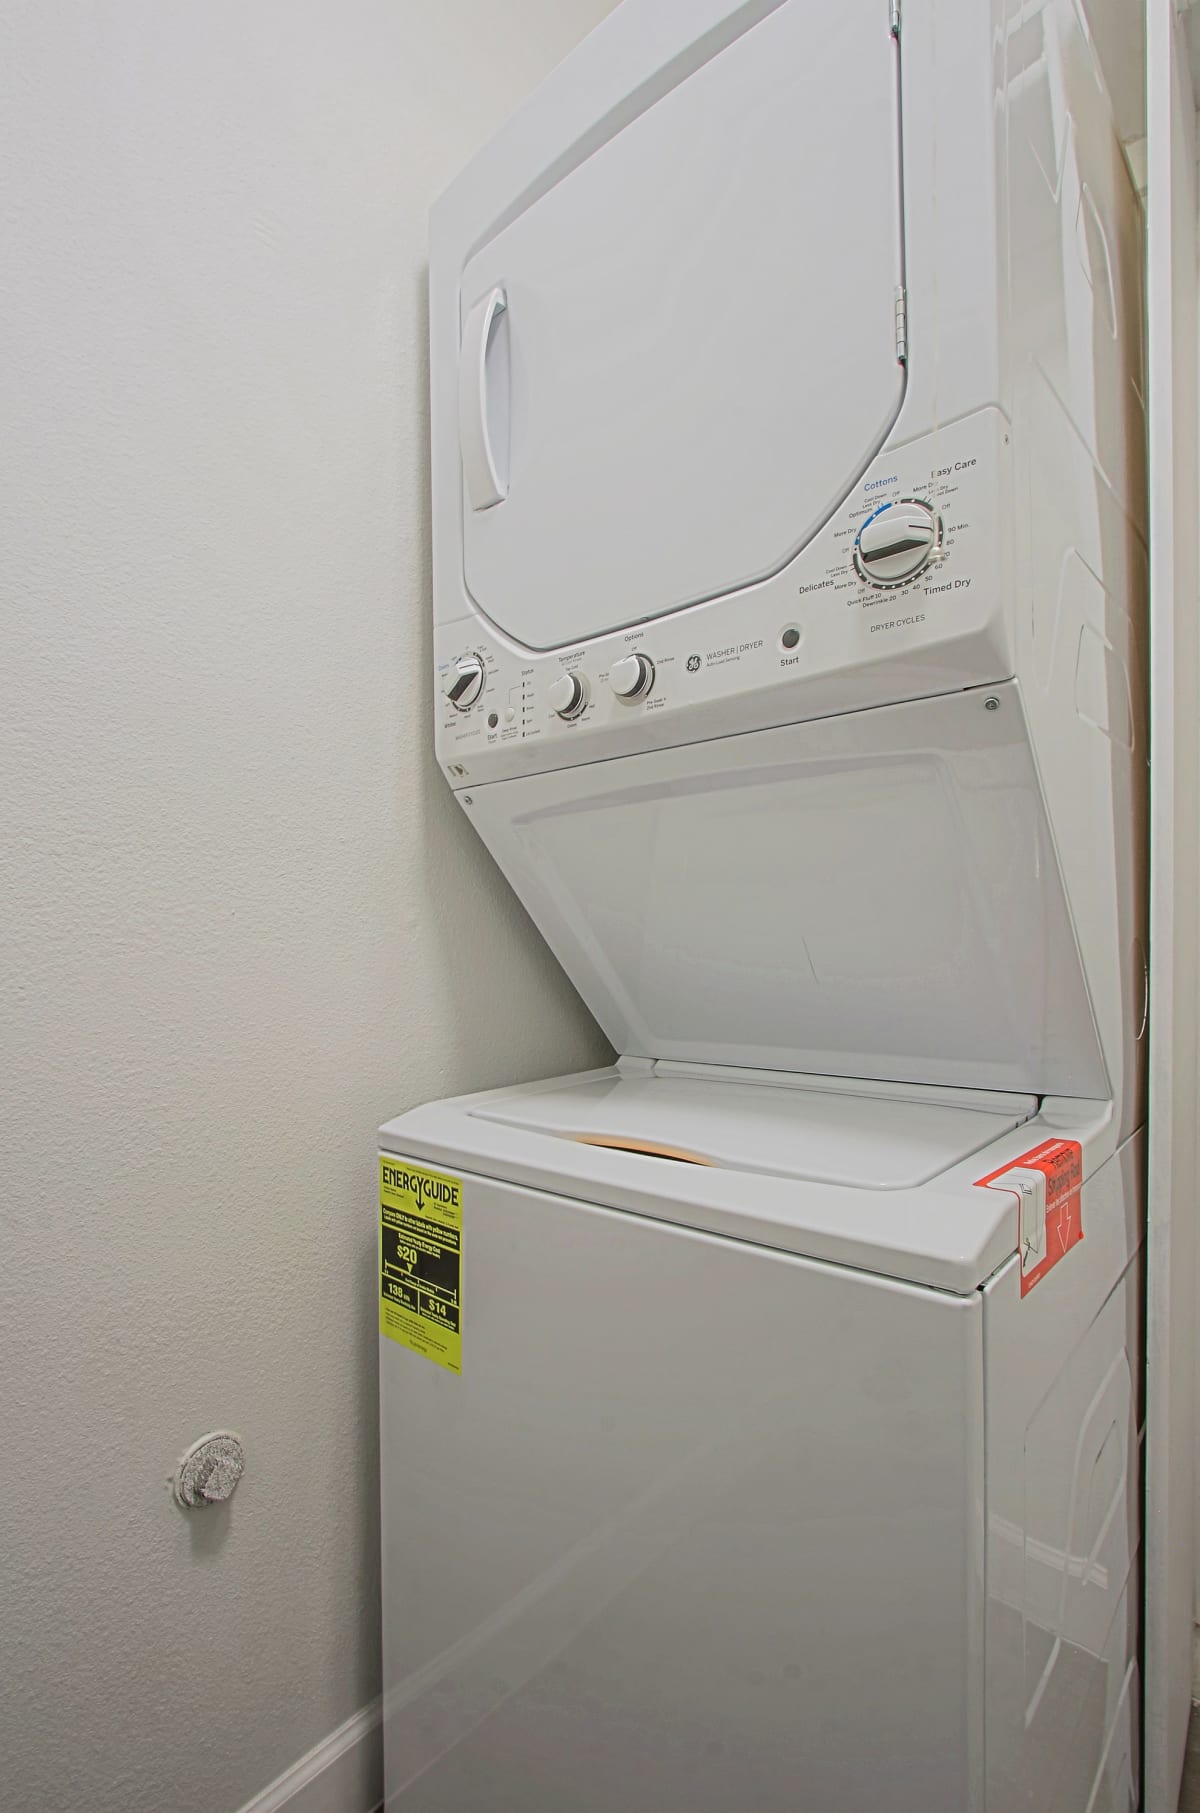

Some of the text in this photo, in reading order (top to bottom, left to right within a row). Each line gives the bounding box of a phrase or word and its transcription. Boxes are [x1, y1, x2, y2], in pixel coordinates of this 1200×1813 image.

[954, 458, 977, 471] Care
[864, 475, 898, 492] Cottons
[913, 484, 927, 493] More
[800, 580, 835, 594] Delicates
[834, 583, 847, 591] More
[923, 578, 971, 596] Timed Dry
[870, 614, 926, 633] DRYER CYCLES
[625, 632, 644, 642] Options
[706, 640, 763, 661] WASHER DRYER
[780, 656, 799, 667] Start
[383, 1166, 459, 1207] ENERGYGUIDE
[397, 1245, 418, 1265] $20
[428, 1299, 446, 1316] $14
